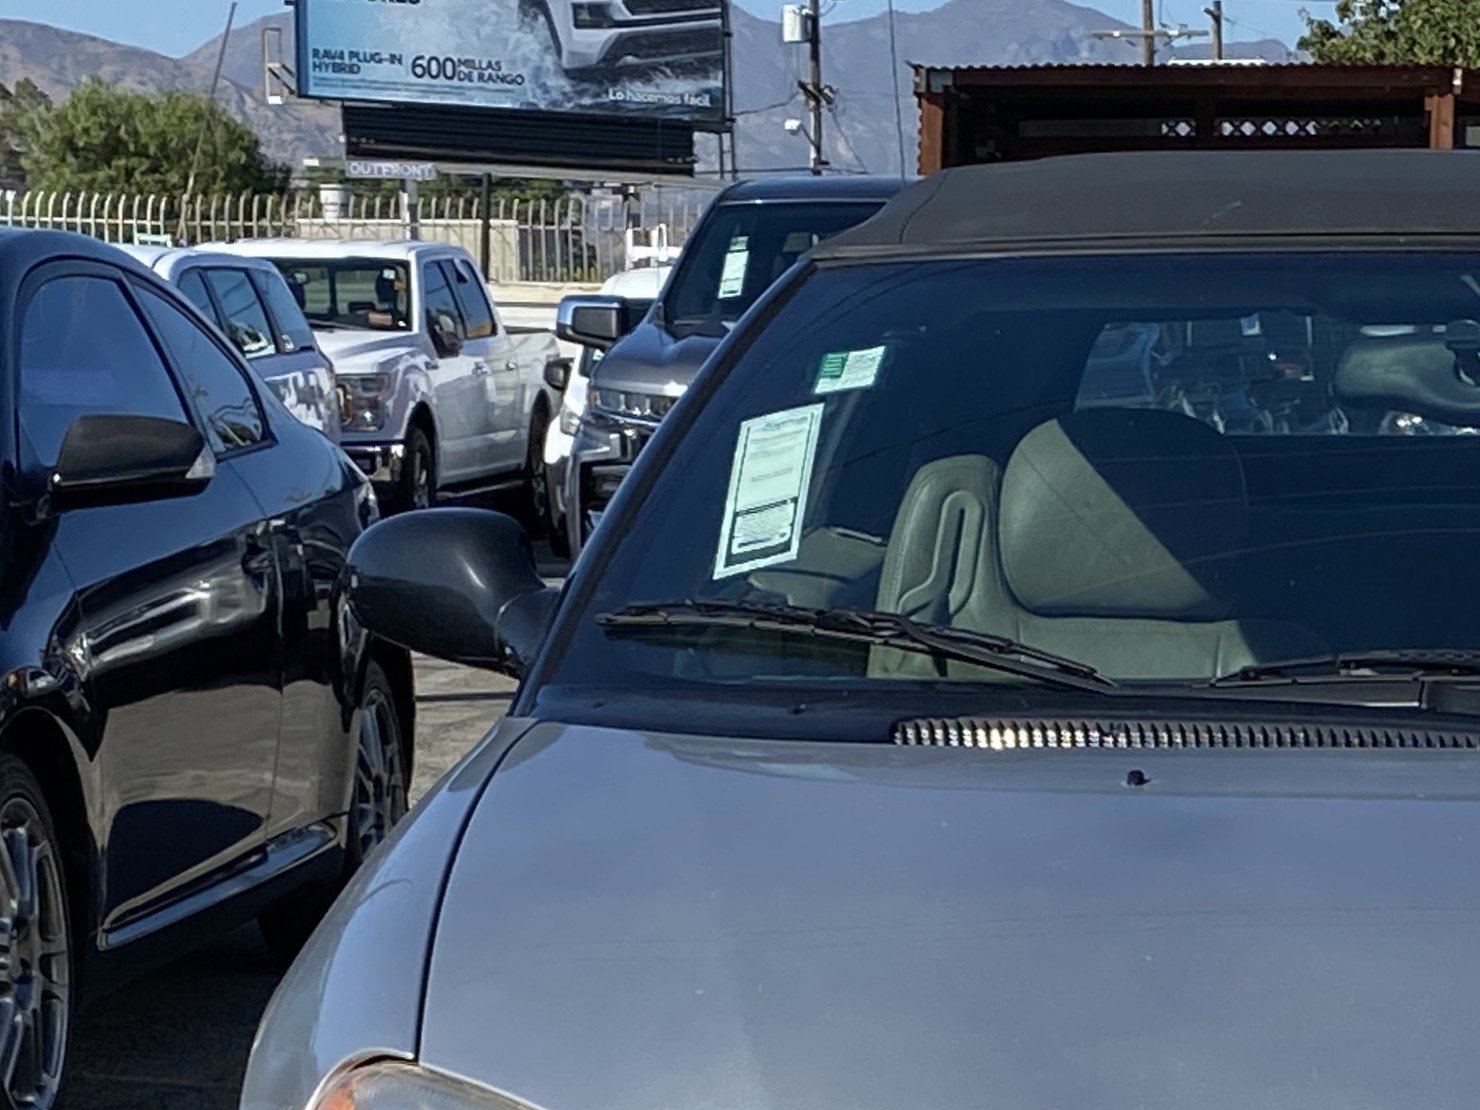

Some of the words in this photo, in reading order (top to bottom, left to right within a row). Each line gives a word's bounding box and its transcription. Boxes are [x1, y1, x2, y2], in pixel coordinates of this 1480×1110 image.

[311, 48, 345, 61] RAV4
[351, 50, 403, 66] PLUG-IN
[457, 58, 502, 72] MILLAS
[311, 61, 361, 75] HYBRID
[411, 55, 457, 80] 600
[457, 70, 474, 83] DE
[478, 71, 525, 86] RANGO
